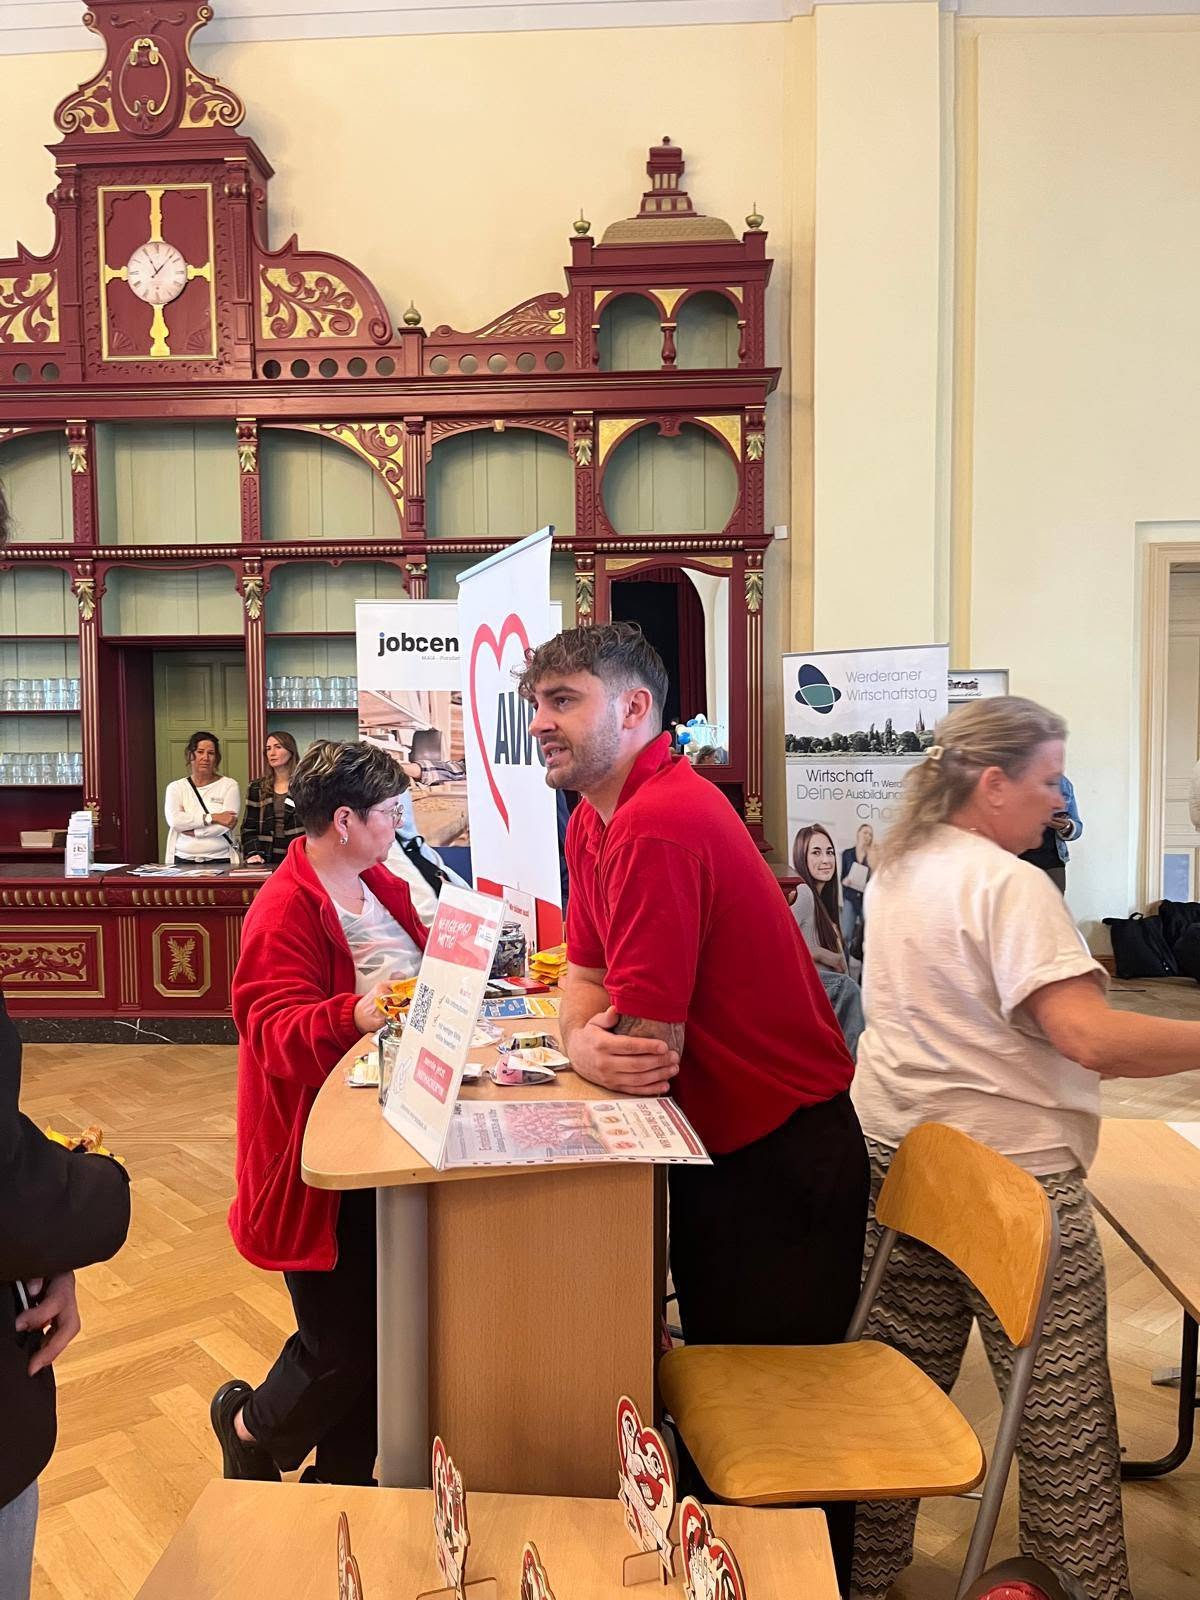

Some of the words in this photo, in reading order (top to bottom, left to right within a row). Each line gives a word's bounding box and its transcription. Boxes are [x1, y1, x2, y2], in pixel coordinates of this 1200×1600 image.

[845, 670, 922, 684] Werderaner
[846, 687, 938, 702] Wirtschaftstag
[806, 769, 874, 783] Wirtschaft
[872, 780, 880, 788] in
[796, 784, 844, 800] Deine
